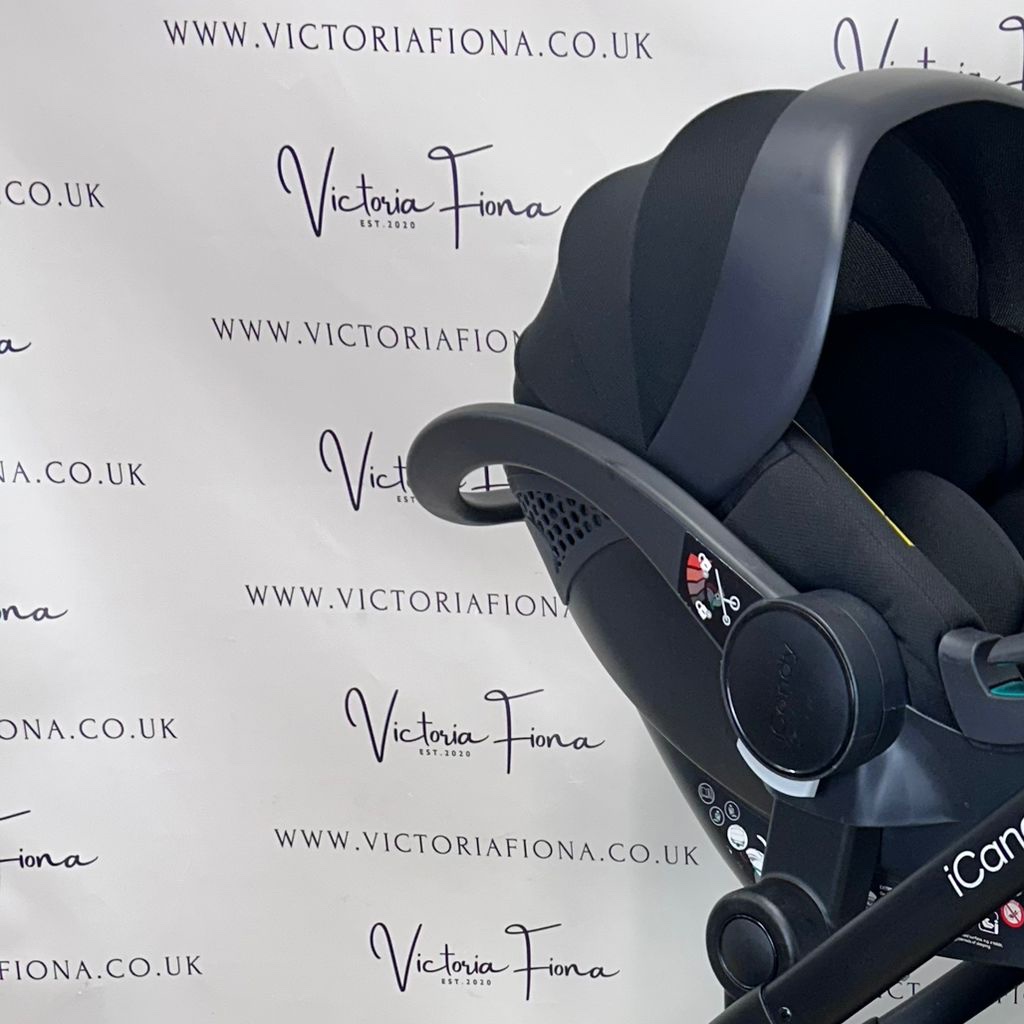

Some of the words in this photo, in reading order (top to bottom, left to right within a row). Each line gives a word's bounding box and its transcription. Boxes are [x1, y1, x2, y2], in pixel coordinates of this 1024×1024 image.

[163, 20, 653, 59] WWW.VICTORIAFIONA.CO.UK
[277, 145, 435, 238] Victoria
[427, 144, 561, 250] Fiona
[360, 219, 415, 229] EST.2020
[211, 317, 521, 353] WWW.VICTORIAFIO
[319, 429, 408, 511] Vict
[245, 583, 569, 618] WWW.VICTORIAFION
[345, 687, 489, 763] Victoria
[484, 689, 605, 775] Fiona
[419, 749, 470, 757] EST.2020
[274, 829, 699, 865] WWW.VICTORIAFIONA.CO.UK
[370, 922, 509, 992] Victoria
[504, 923, 620, 1001] Fiona
[441, 978, 491, 986] EST.2020
